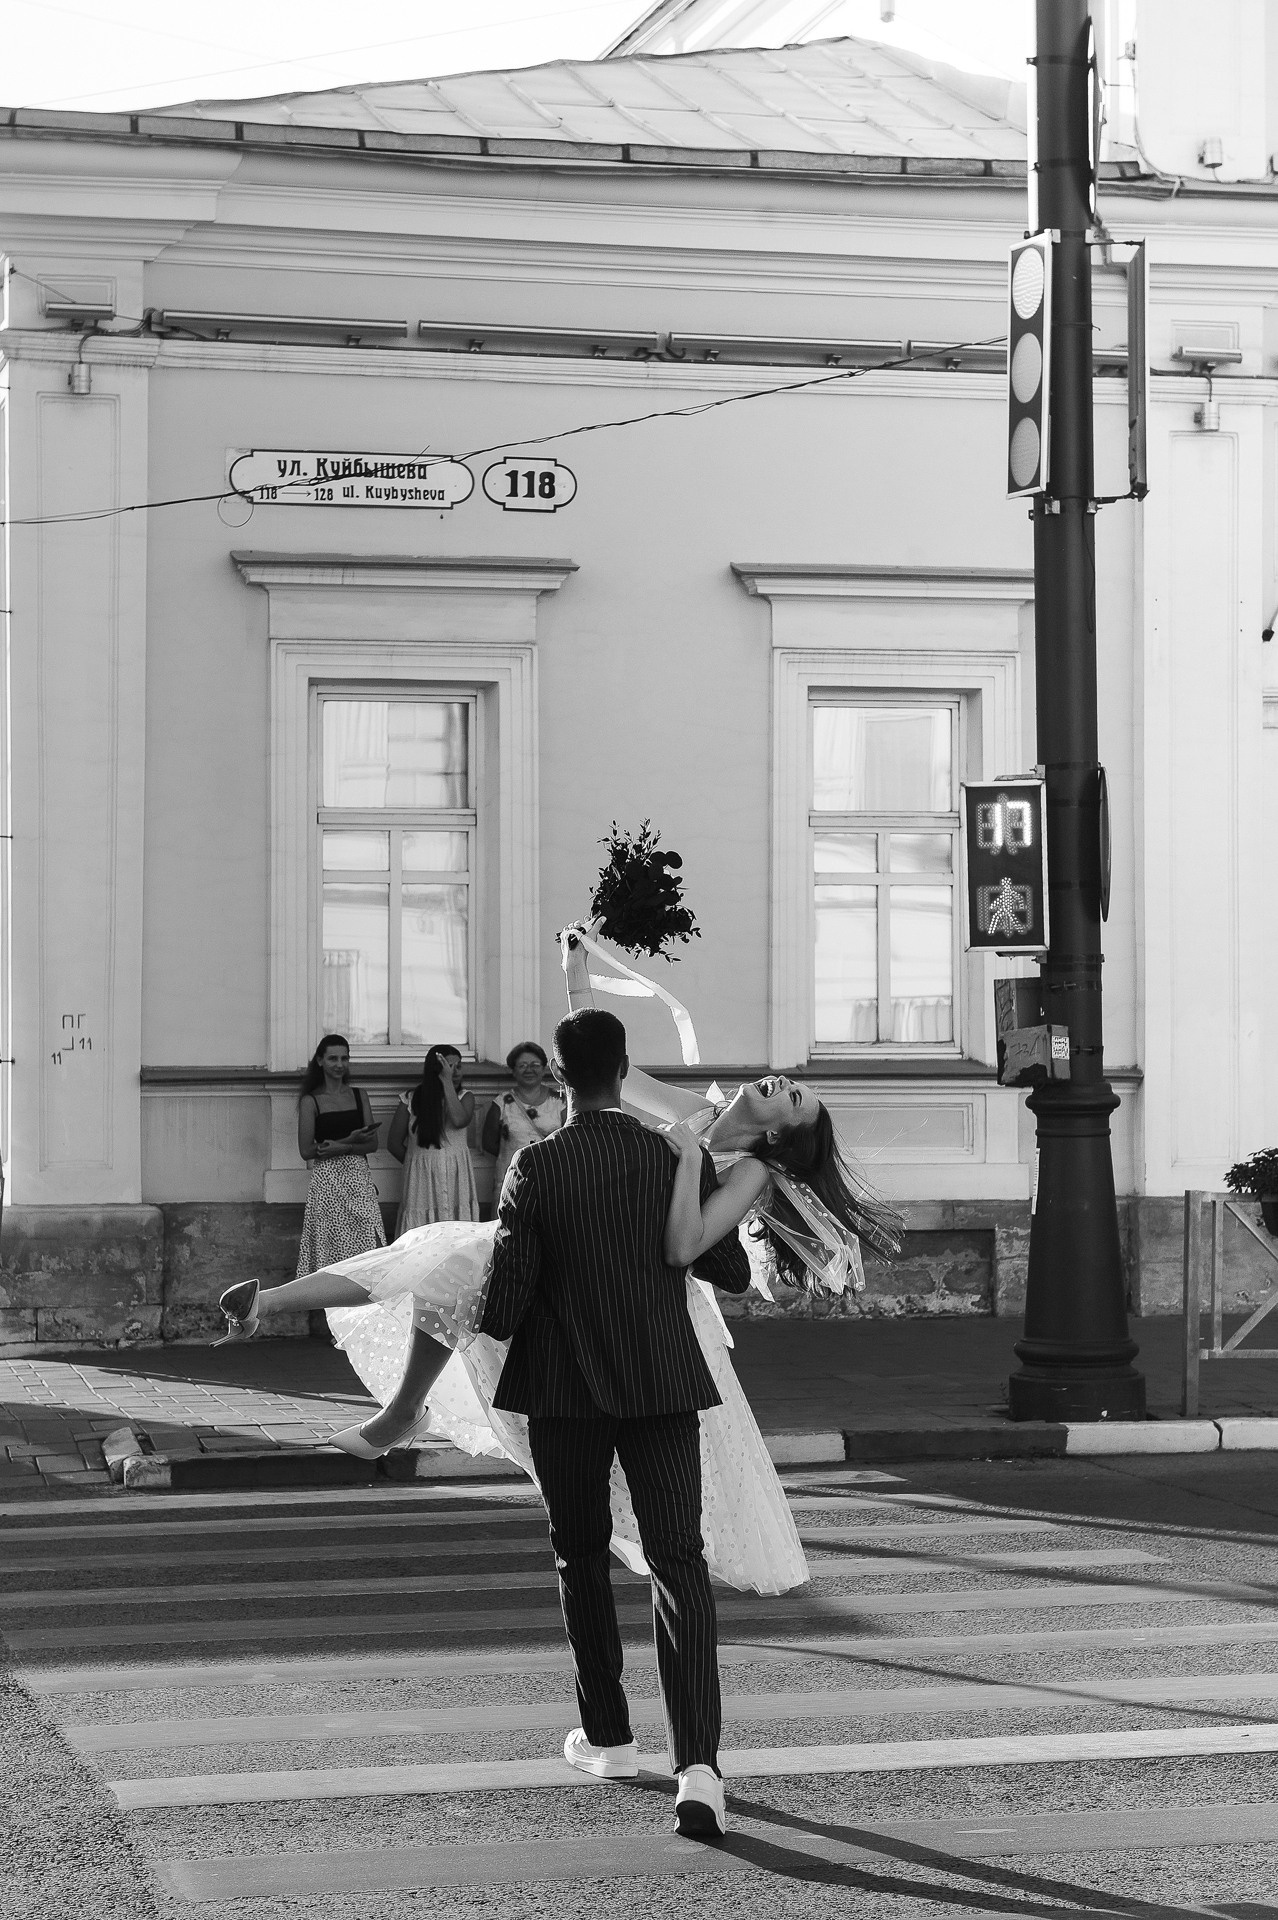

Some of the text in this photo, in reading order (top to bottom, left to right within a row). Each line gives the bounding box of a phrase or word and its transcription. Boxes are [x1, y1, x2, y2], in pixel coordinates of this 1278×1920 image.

[277, 457, 427, 480] ул. Куйбышева
[314, 488, 334, 501] 128
[342, 485, 445, 501] ul. Kuybysheva
[505, 469, 556, 499] 118
[994, 800, 1033, 848] 17
